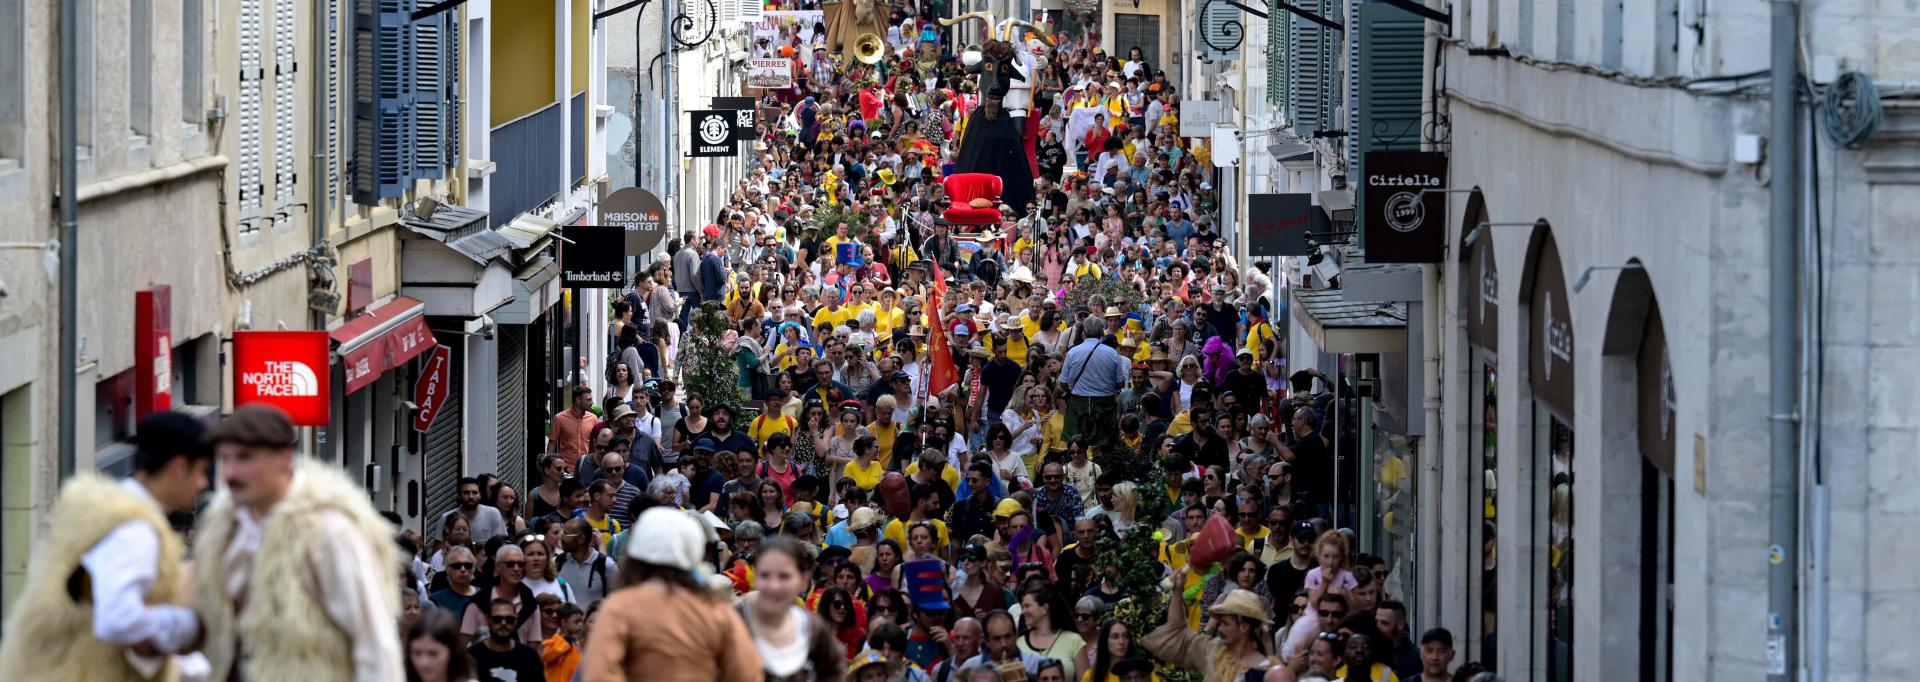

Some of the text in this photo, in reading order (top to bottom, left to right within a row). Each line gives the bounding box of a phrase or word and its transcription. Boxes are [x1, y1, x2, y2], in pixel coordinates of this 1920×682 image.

[752, 60, 787, 68] PIERRES
[1184, 120, 1215, 128] LACOST
[699, 145, 730, 153] ELEMENT
[1369, 174, 1440, 186] Cirielle
[565, 270, 611, 282] Timberland
[264, 361, 292, 373] THE
[242, 372, 292, 385] NORTH
[257, 384, 292, 396] FACE
[420, 356, 444, 422] TABAC
